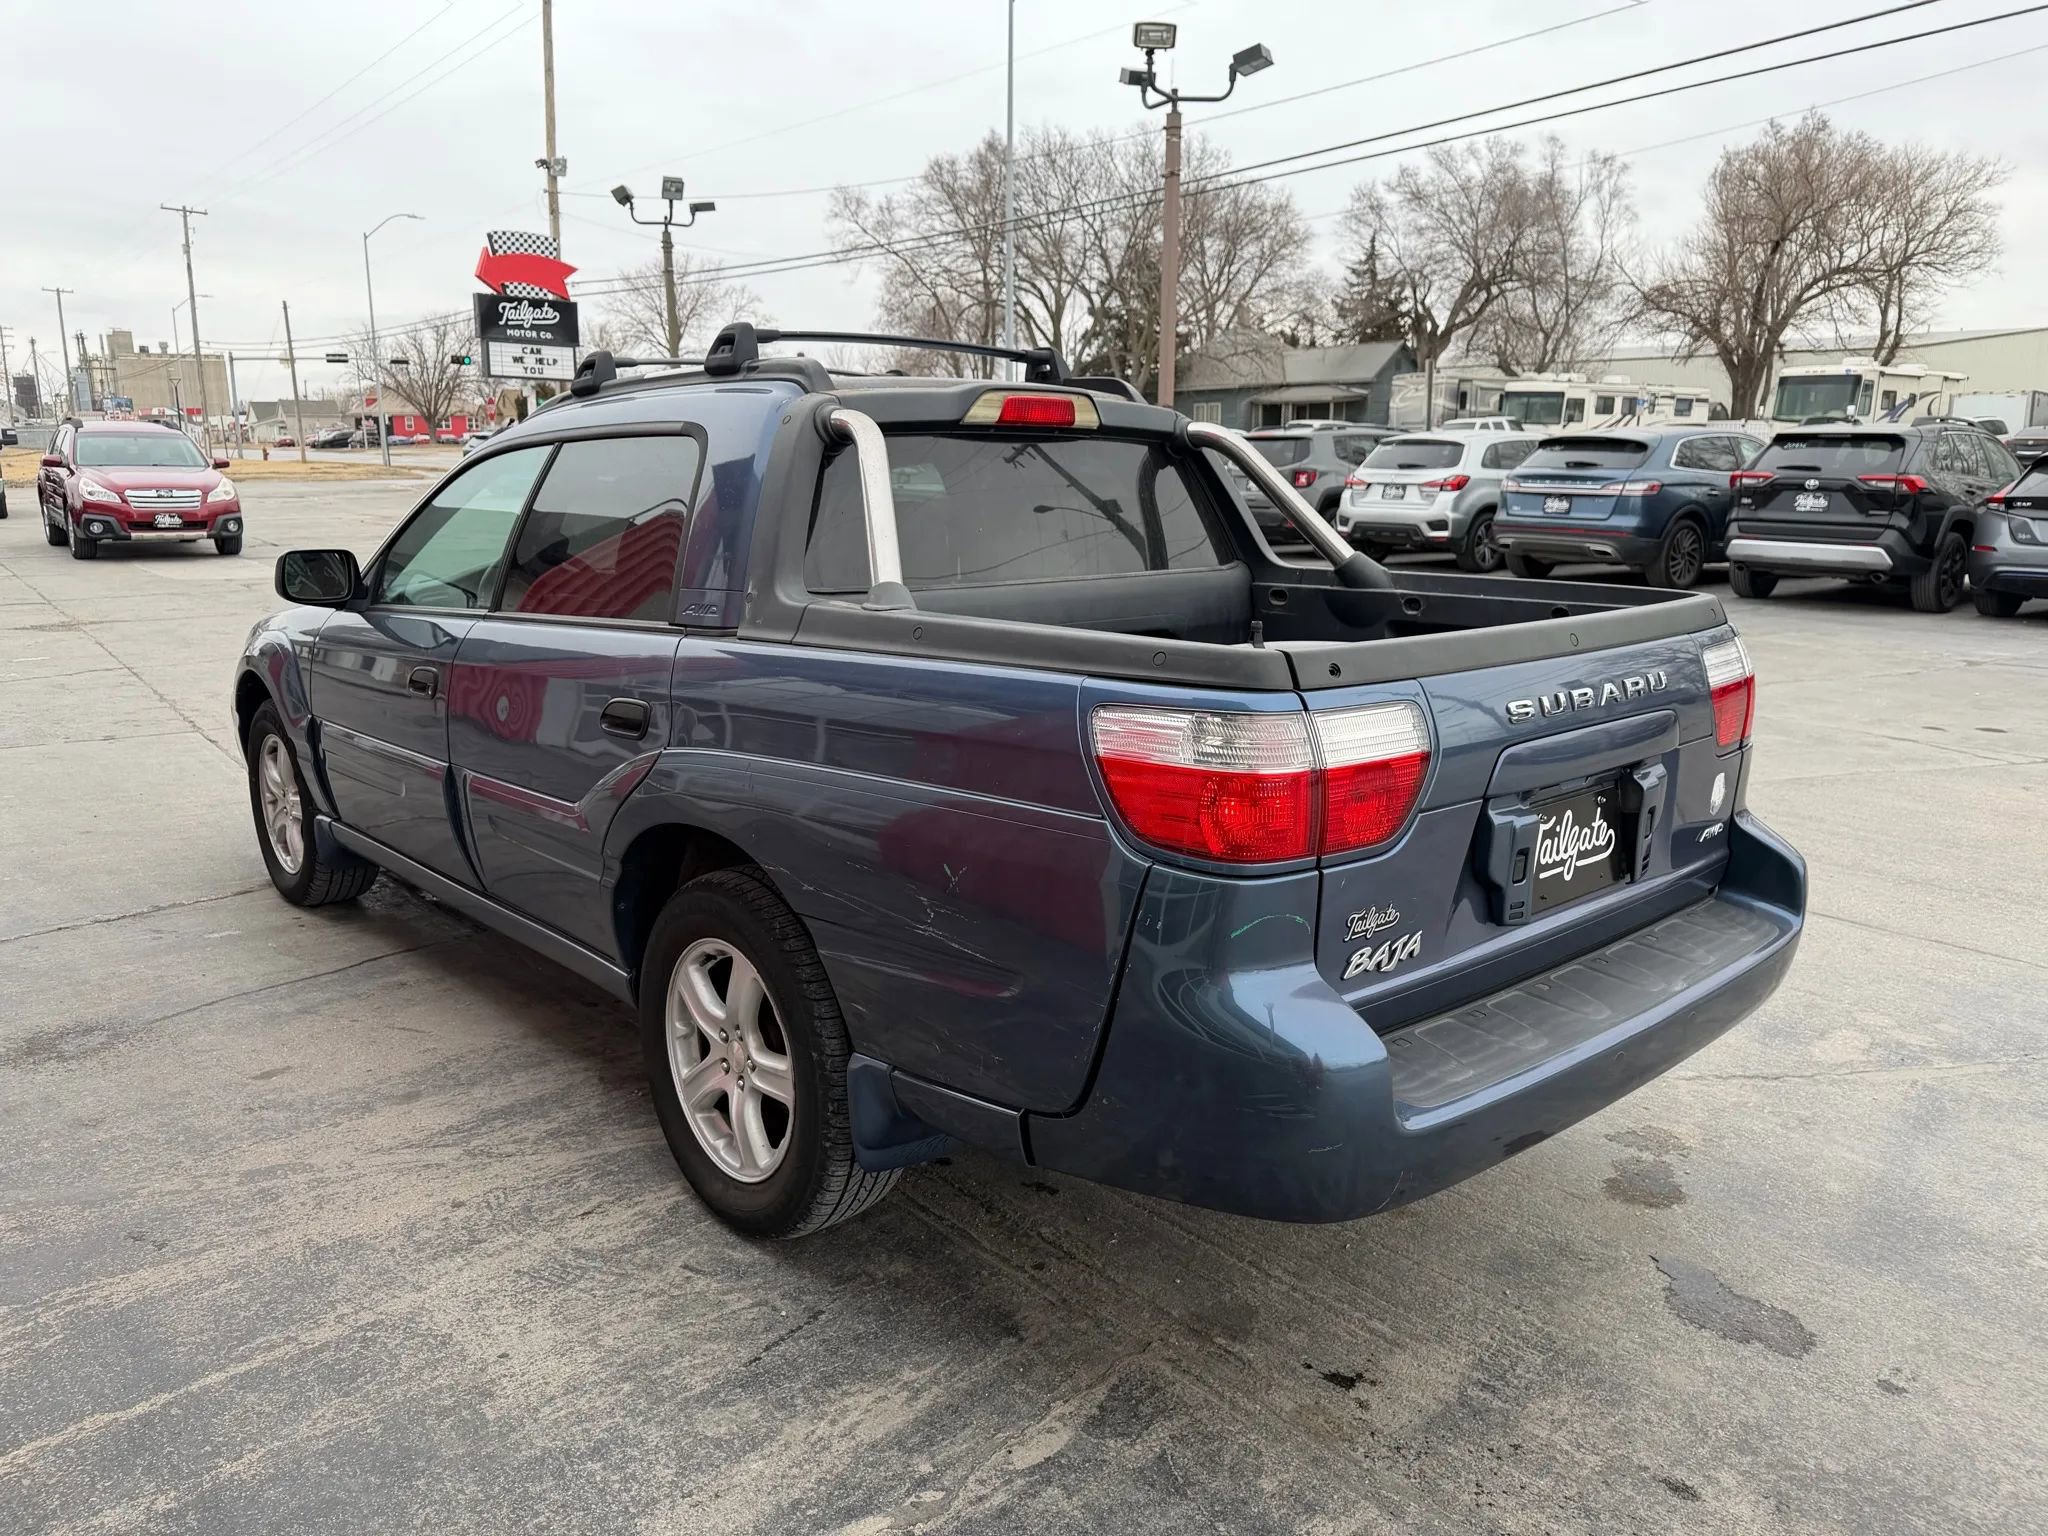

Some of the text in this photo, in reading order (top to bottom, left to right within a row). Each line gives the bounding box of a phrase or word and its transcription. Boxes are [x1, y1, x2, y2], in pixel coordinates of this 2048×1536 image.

[498, 300, 560, 328] Tailgate
[507, 329, 537, 338] MOTOR
[512, 356, 558, 366] WE HELP
[522, 347, 541, 355] CAN
[523, 367, 544, 375] YOU
[1506, 671, 1667, 724] SUBARU
[1533, 807, 1615, 881] Tailgate
[1344, 903, 1400, 941] Tailgate
[1343, 930, 1422, 979] BAJA
